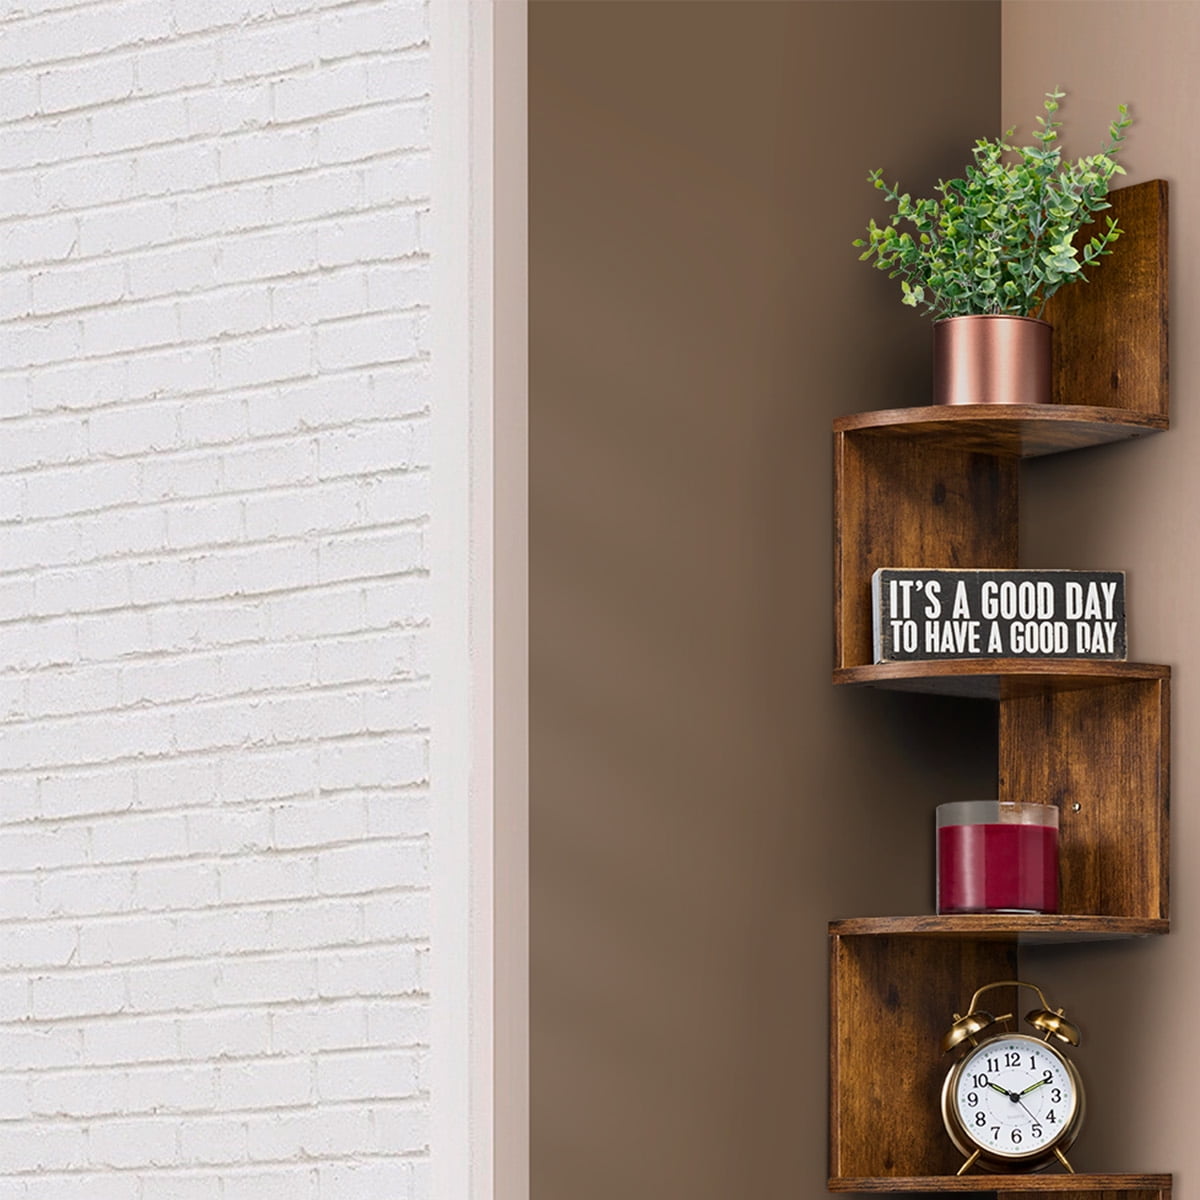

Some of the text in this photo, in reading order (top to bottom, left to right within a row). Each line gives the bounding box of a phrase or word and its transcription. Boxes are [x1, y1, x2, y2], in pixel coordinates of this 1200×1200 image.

[890, 580, 1117, 620] IT'S A GOOD DAY
[890, 621, 1117, 653] TO HAVE A GOOD DAY
[987, 1058, 1000, 1072] 11
[1005, 1052, 1021, 1067] 12
[1030, 1056, 1037, 1070] 1
[972, 1073, 988, 1088] 10
[1042, 1070, 1053, 1084] 2
[967, 1092, 979, 1107] 9
[1051, 1088, 1062, 1103] 3
[975, 1111, 986, 1126] 8
[1045, 1109, 1056, 1124] 4
[990, 1126, 1001, 1140] 7
[1011, 1129, 1022, 1144] 6
[1031, 1123, 1042, 1138] 5
